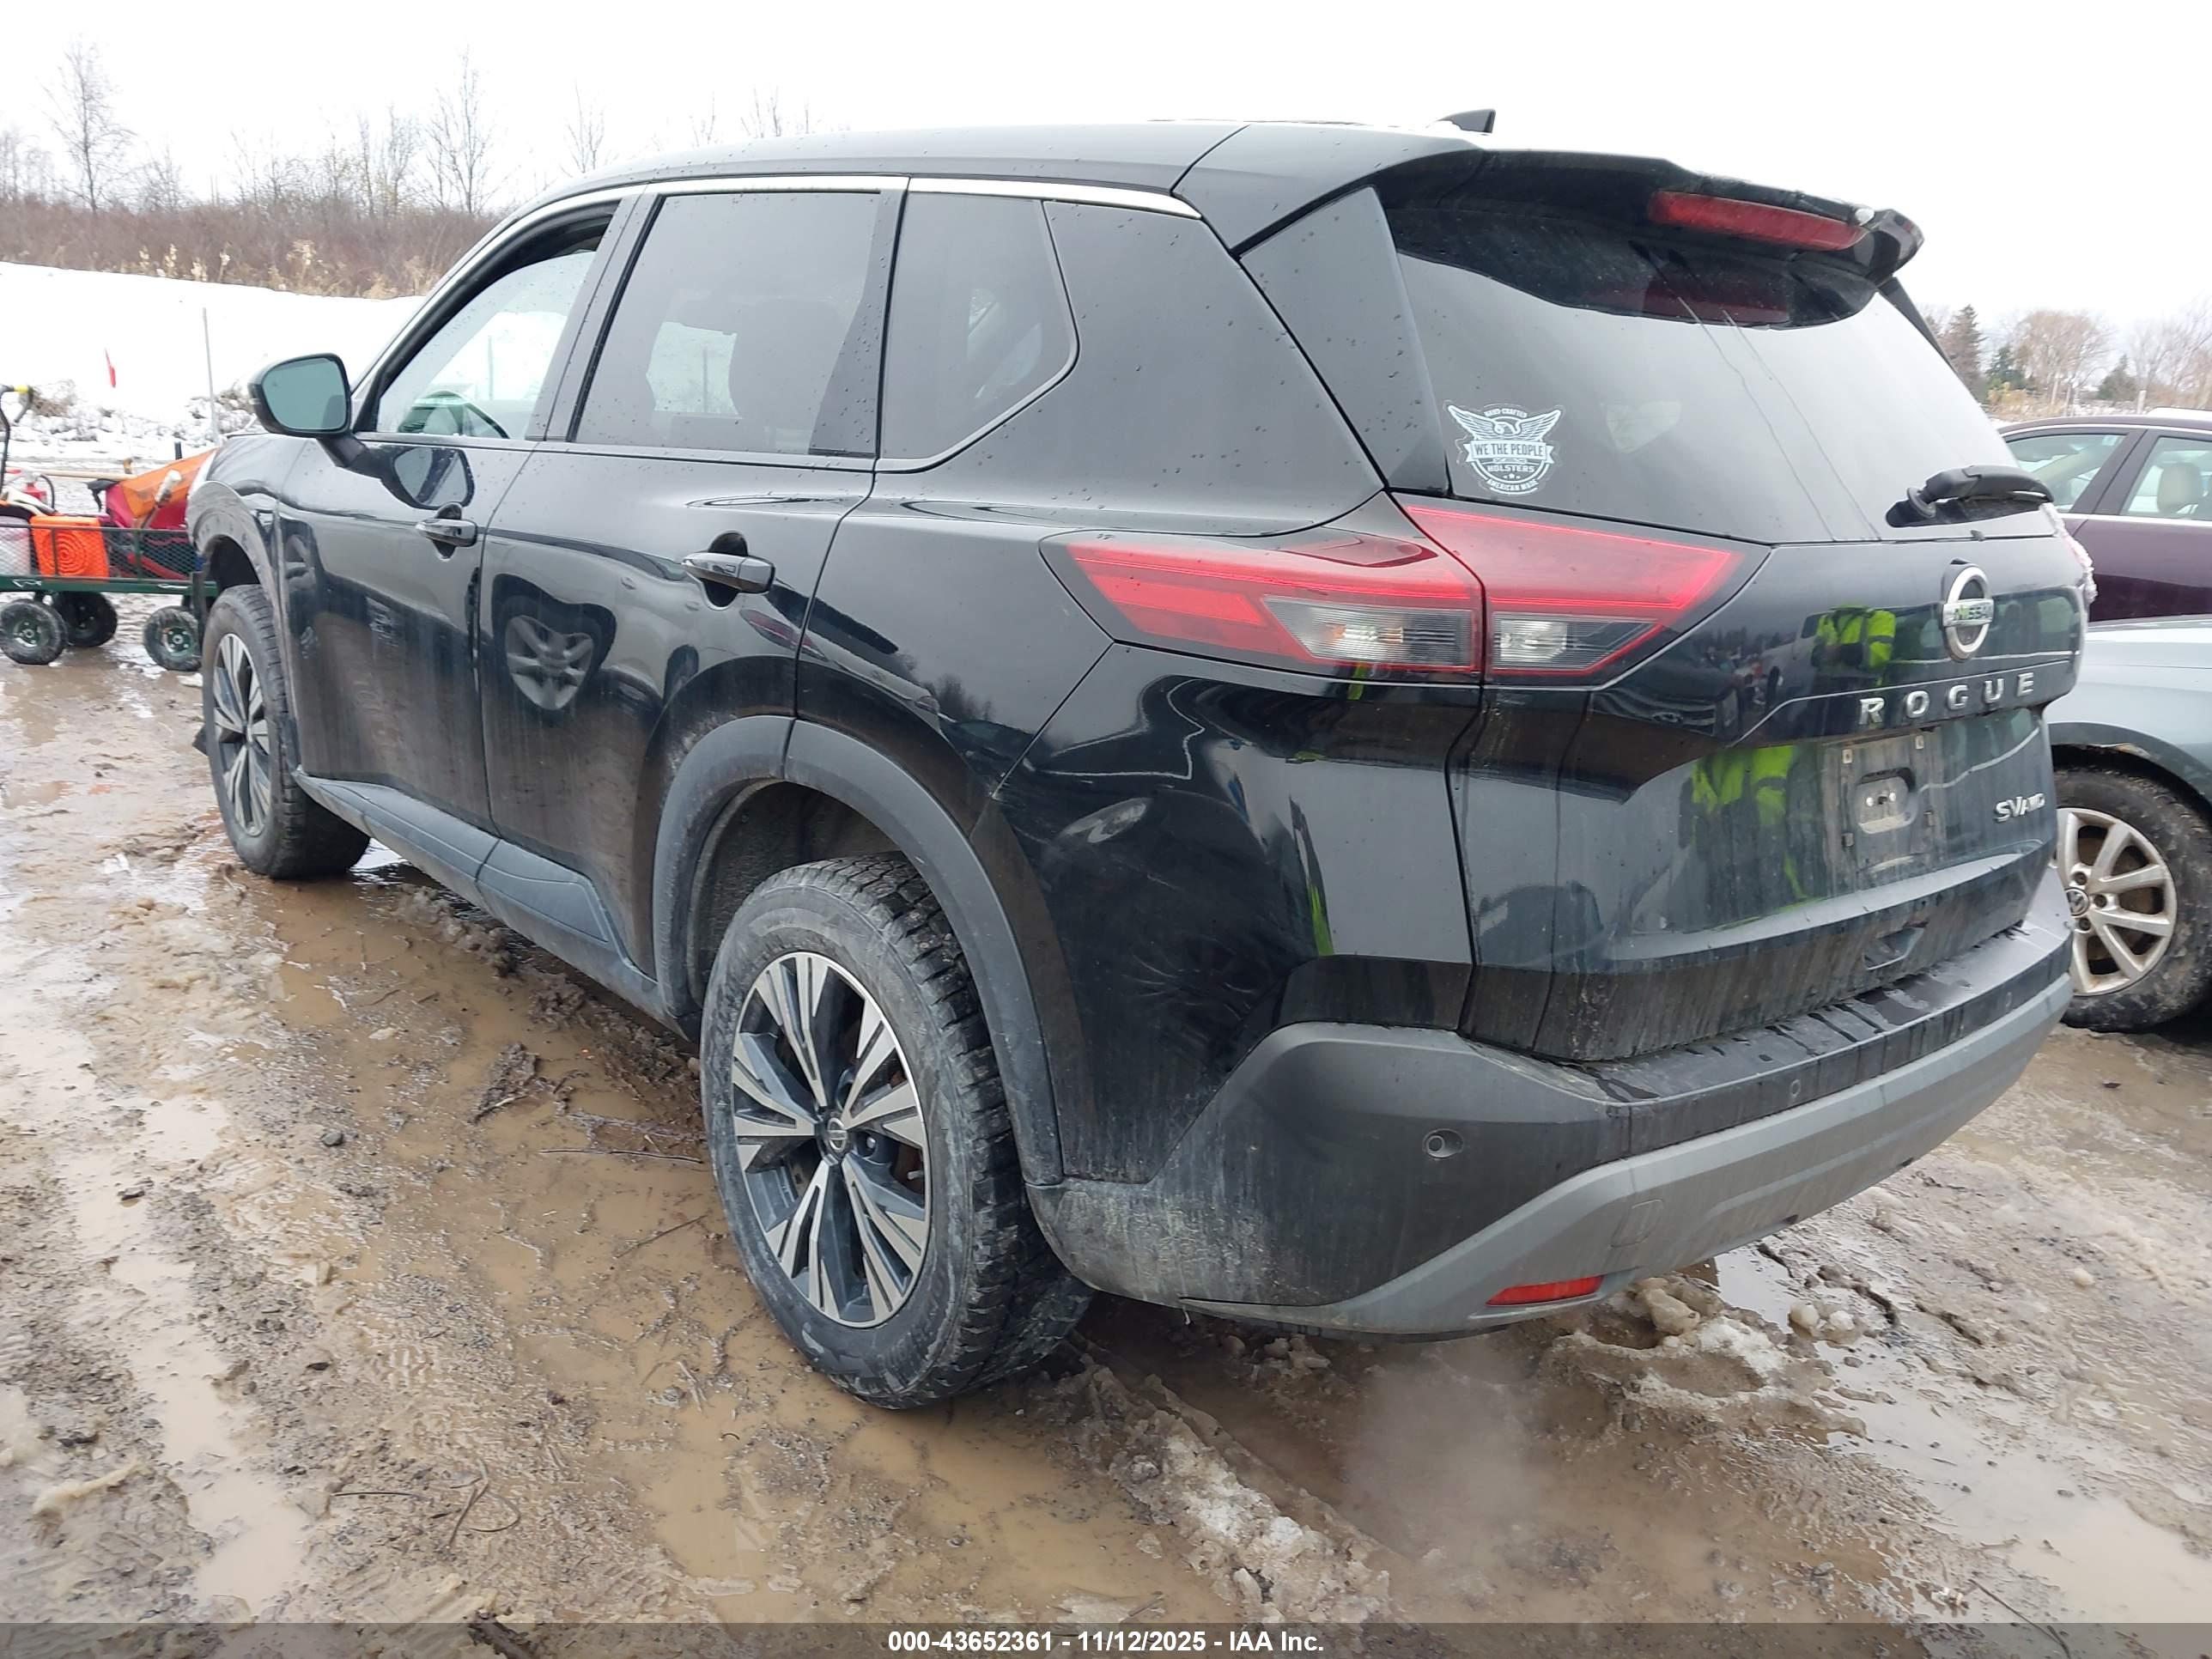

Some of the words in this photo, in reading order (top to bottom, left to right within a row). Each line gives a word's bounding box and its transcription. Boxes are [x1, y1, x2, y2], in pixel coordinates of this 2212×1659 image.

[1474, 443, 1488, 455] WE
[1491, 443, 1508, 455] THE
[1511, 443, 1544, 457] PEOPLE
[1487, 465, 1535, 473] HOLSTERS
[1859, 672, 2034, 725] ROGUE
